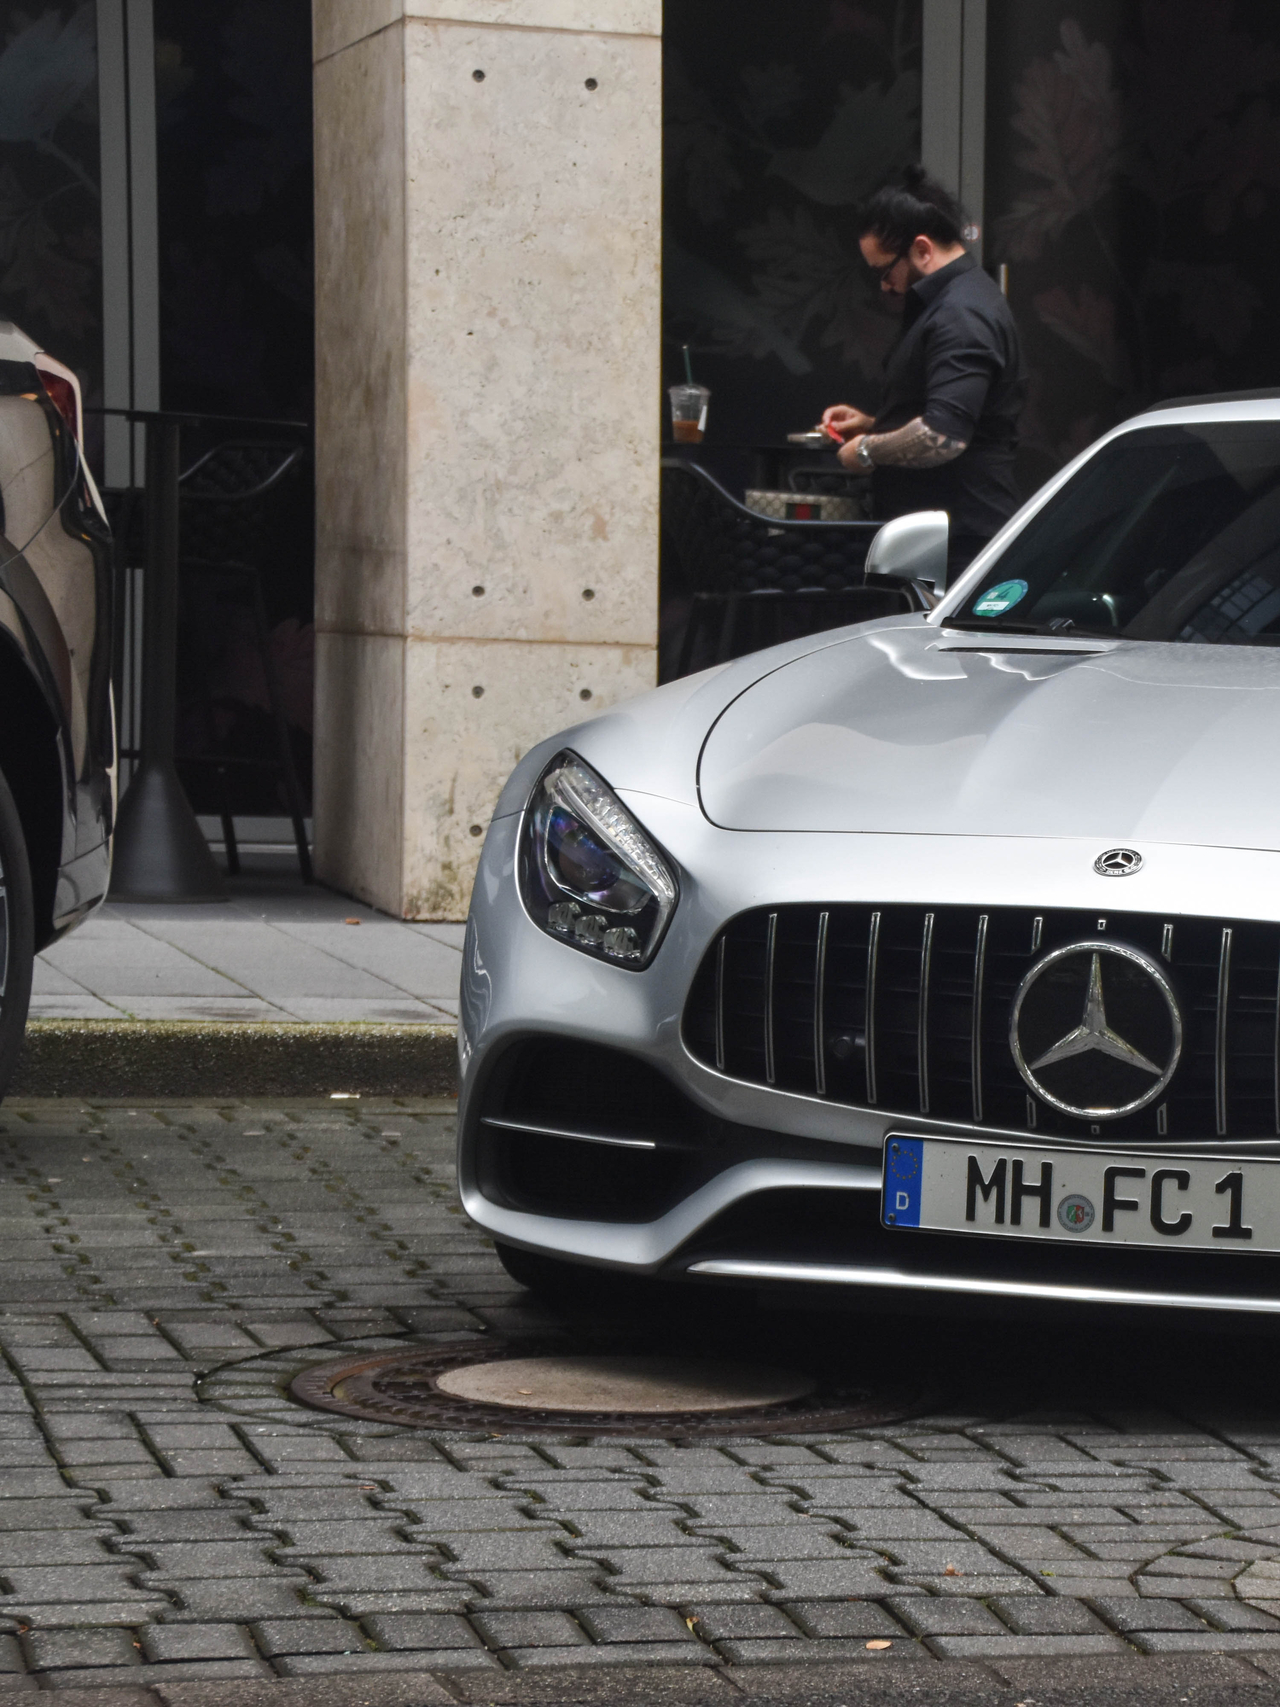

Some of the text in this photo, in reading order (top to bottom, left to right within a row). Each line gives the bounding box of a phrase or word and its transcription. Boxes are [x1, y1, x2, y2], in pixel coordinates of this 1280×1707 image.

[996, 585, 1014, 600] 4
[895, 1191, 910, 1210] D
[965, 1155, 1053, 1228] MH
[1101, 1165, 1193, 1236] FC
[1211, 1171, 1253, 1239] 1
